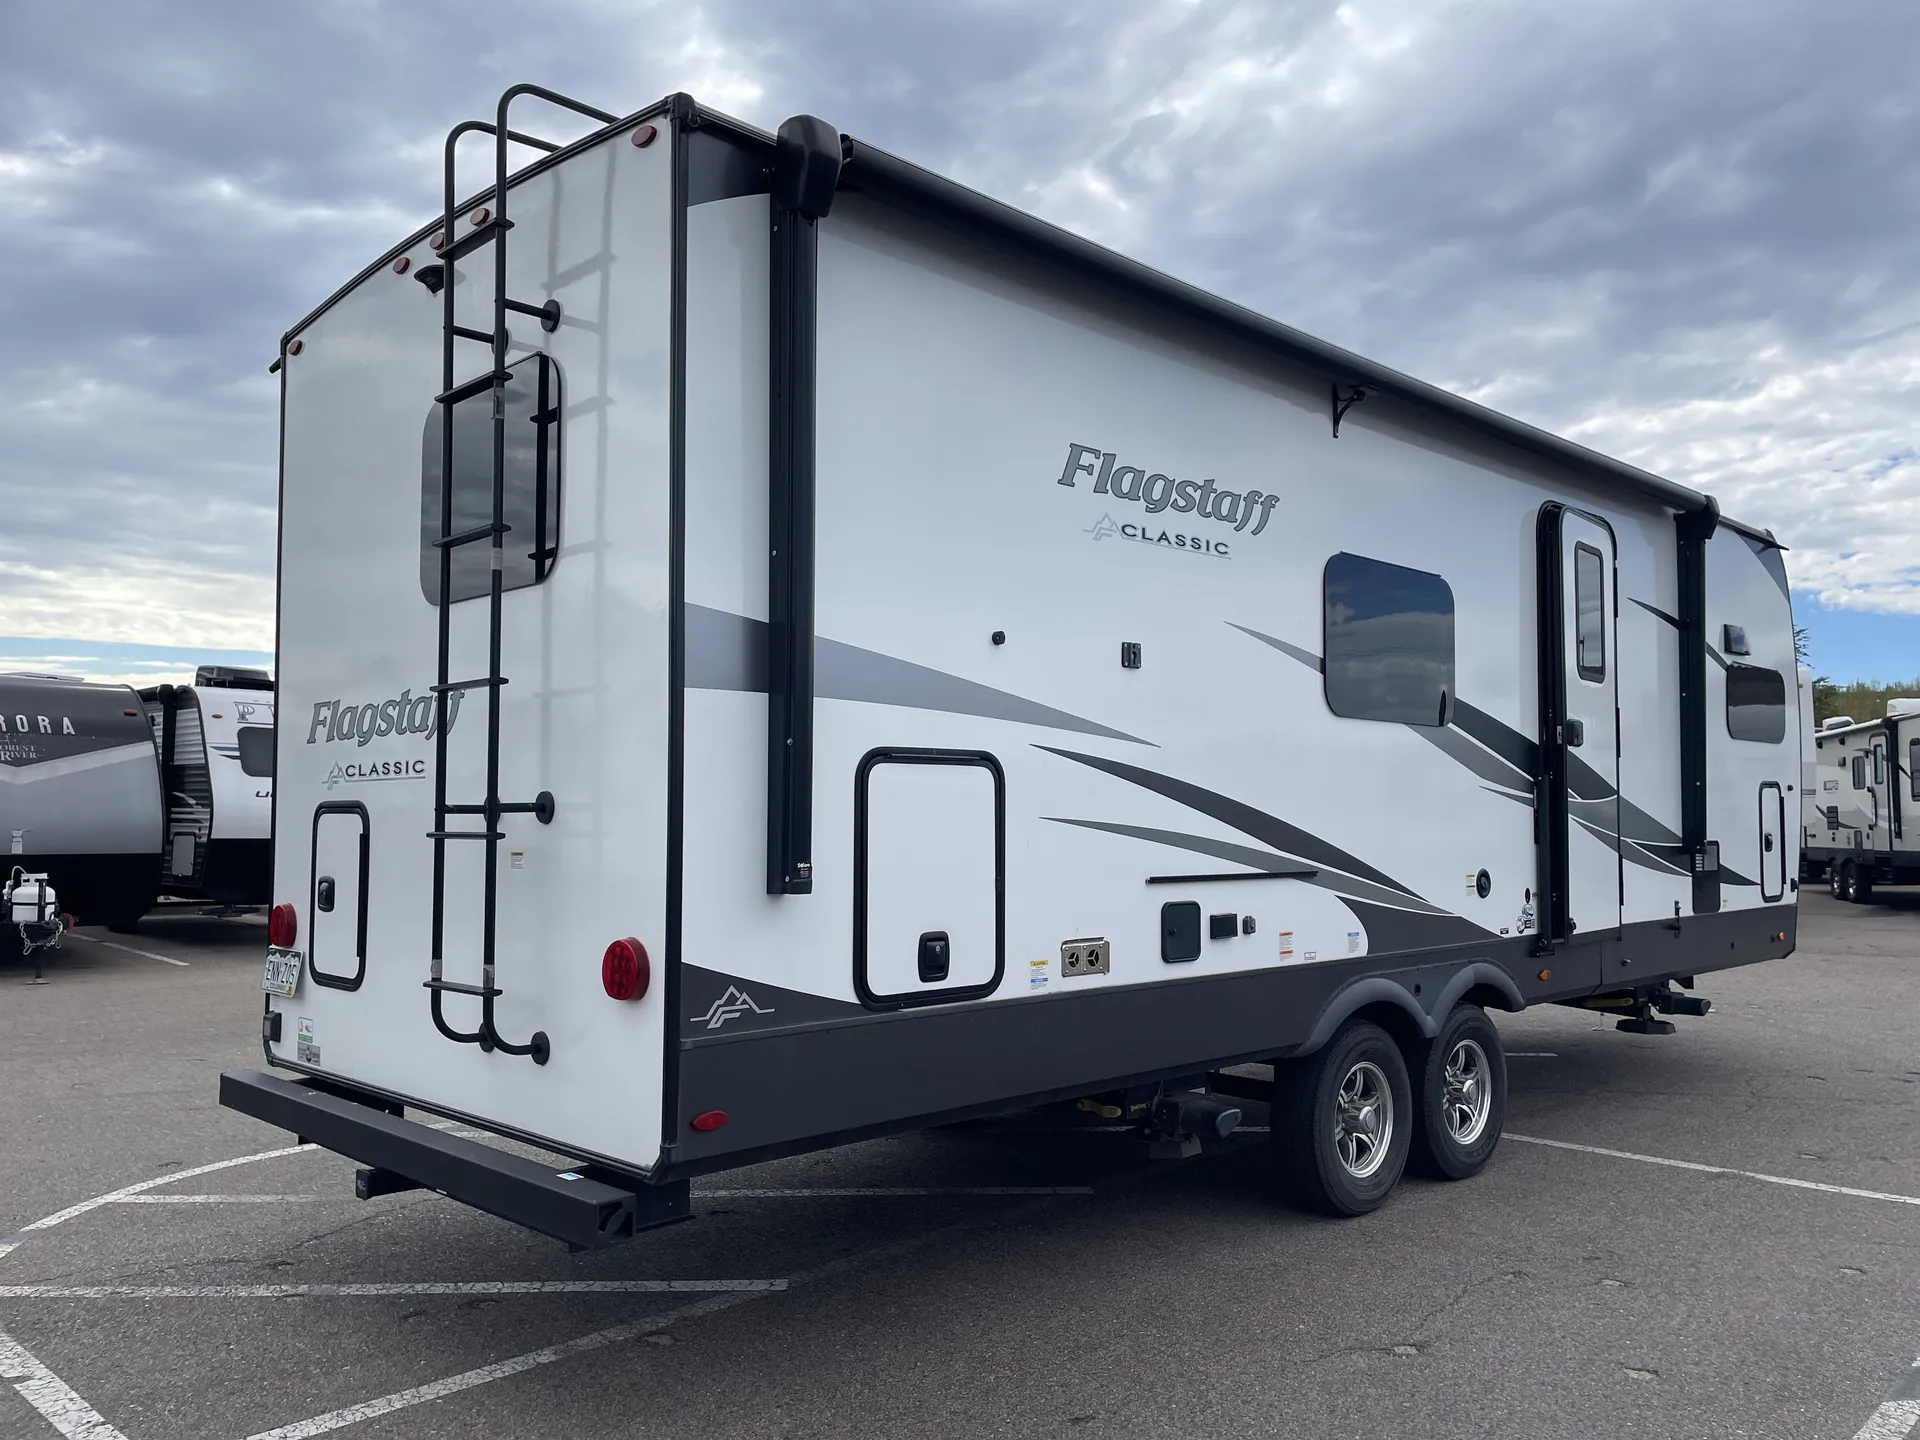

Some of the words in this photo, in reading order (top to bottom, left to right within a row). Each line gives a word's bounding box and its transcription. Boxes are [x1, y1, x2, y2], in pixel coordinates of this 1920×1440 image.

[1057, 442, 1280, 536] Flagstaff
[1121, 524, 1230, 555] CLASSIC
[345, 760, 425, 777] CLASSIC
